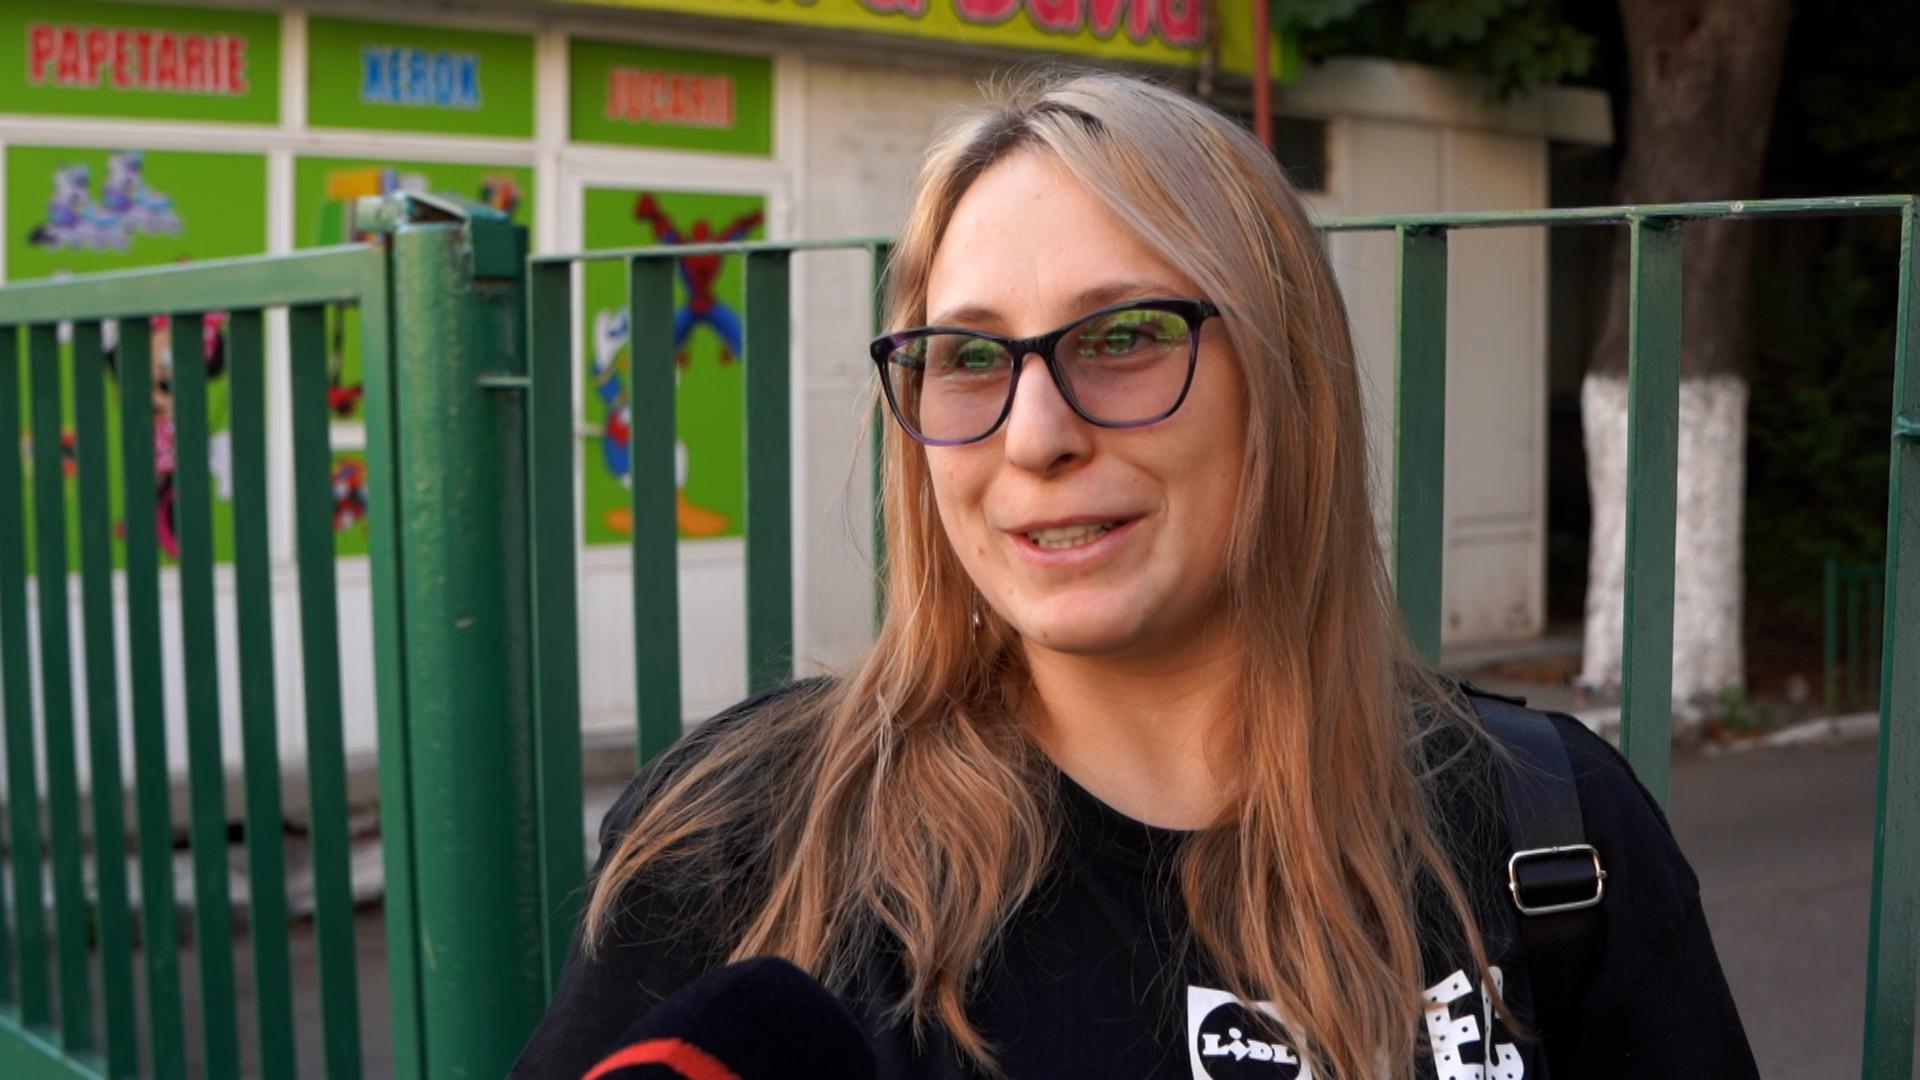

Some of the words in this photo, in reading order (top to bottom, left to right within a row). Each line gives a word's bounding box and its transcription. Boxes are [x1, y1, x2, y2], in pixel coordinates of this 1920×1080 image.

[28, 23, 247, 94] PAPETARIE
[361, 46, 482, 108] XEROX
[605, 67, 734, 127] JUCARII
